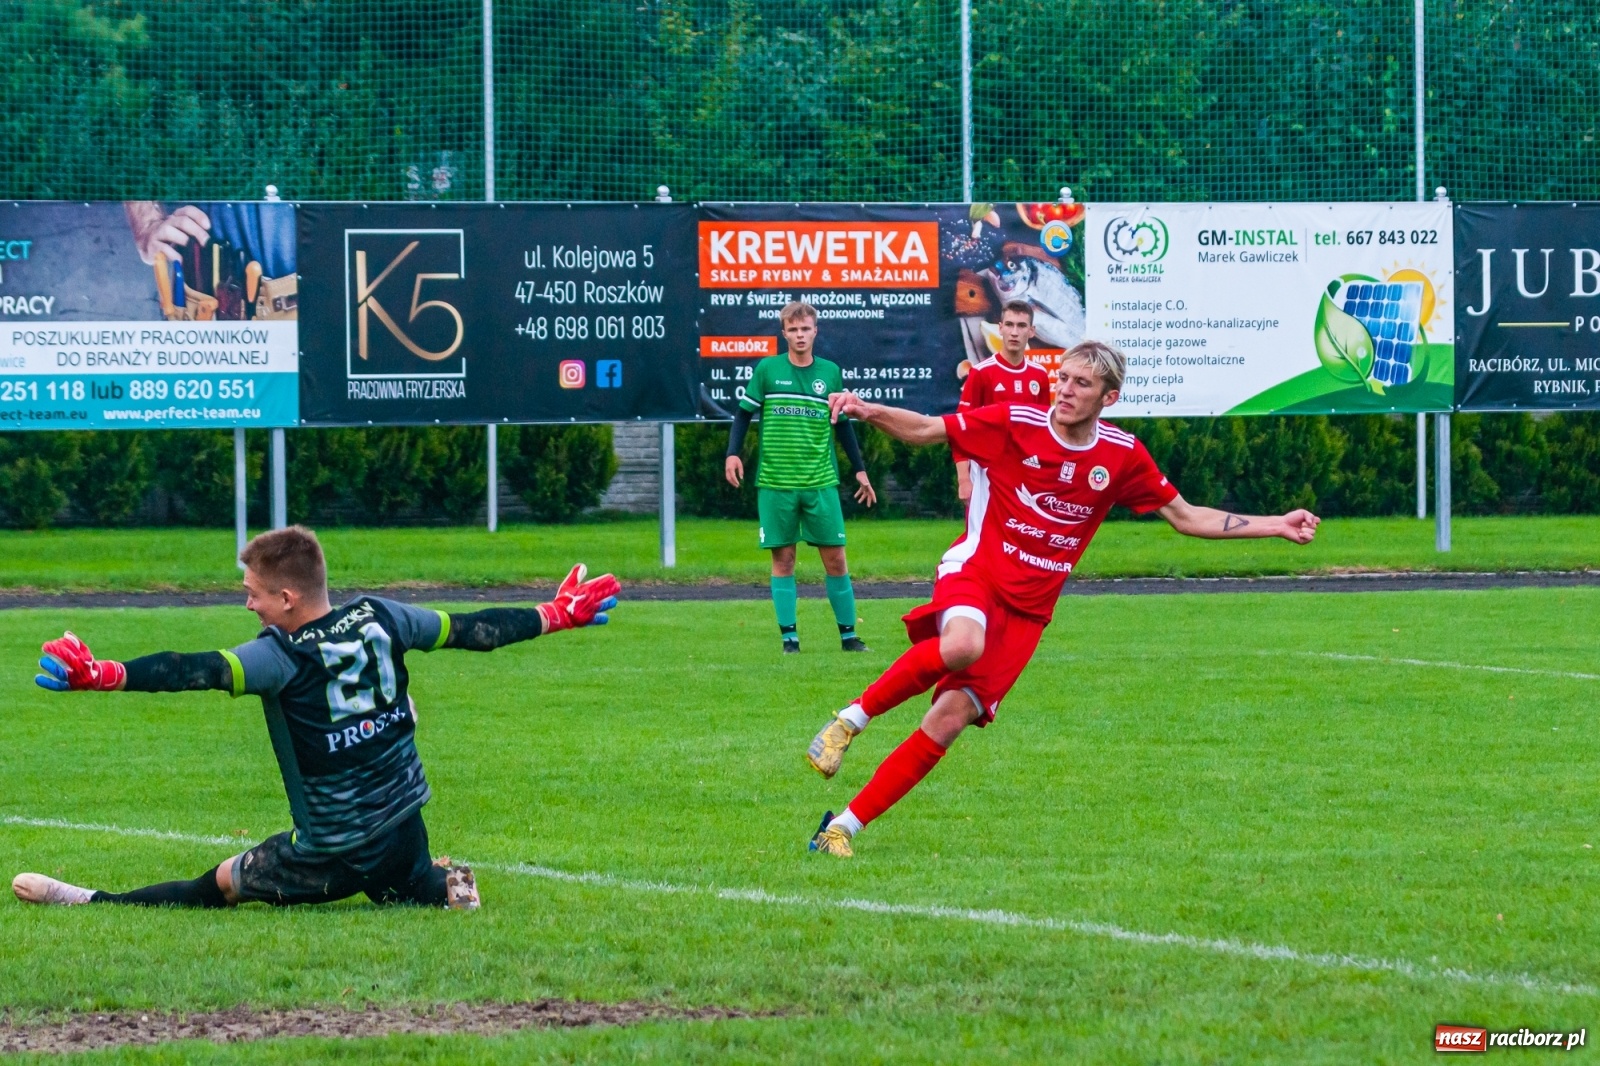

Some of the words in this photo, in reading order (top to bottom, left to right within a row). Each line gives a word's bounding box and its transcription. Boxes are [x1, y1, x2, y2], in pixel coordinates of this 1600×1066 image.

[1198, 229, 1298, 246] GM-INSTAL
[1314, 230, 1341, 245] tel.
[1346, 230, 1375, 245] 667
[1378, 230, 1406, 245] 843
[1410, 230, 1438, 244] 022
[710, 231, 929, 264] KREWETKA
[524, 245, 546, 268] ul.
[553, 245, 636, 273] Kolejowa
[643, 245, 654, 268] 5
[1198, 251, 1235, 263] Marek
[1239, 250, 1299, 263] Gawliczek
[710, 270, 757, 282] SKLEP
[763, 269, 812, 282] RYBNY
[821, 269, 832, 282] &
[841, 267, 929, 282] SMAŻALNIA
[1107, 263, 1164, 274] GM-INSTAL
[515, 281, 577, 304] 47-450
[584, 280, 664, 303] Roszków
[711, 294, 743, 305] RYBY
[801, 291, 866, 307] MROŻONE,
[870, 294, 931, 308] WĘDZONE
[0, 296, 54, 315] RACY
[1111, 300, 1162, 313] instalacje
[1166, 300, 1187, 311] C.O.
[816, 310, 884, 319] ŁODKOWODNE
[514, 317, 548, 340] +48
[554, 316, 588, 340] 698
[595, 316, 625, 339] 061
[632, 315, 665, 339] 803
[1111, 318, 1162, 331] instalacje
[1165, 317, 1279, 331] wodno-kanalizacyjne
[12, 331, 136, 346] POSZUKUJEMY
[141, 327, 269, 345] PRACOWNIKÓW
[1165, 338, 1207, 350] gazowe
[711, 338, 768, 353] RACIBÓRZ
[56, 352, 81, 367] DO
[86, 349, 152, 366] BRANŻY
[157, 350, 269, 366] BUDOWALNEJ
[1127, 356, 1162, 368] talacje
[1165, 355, 1245, 366] fotowoltaiczne
[1469, 355, 1544, 373] RACIBÓRZ,
[1548, 358, 1571, 372] UL.
[711, 368, 731, 380] UL.
[842, 367, 861, 379] tel.
[863, 368, 877, 379] 32
[879, 368, 900, 379] 415
[902, 368, 916, 379] 22
[918, 368, 932, 379] 32
[1125, 376, 1149, 387] mpy
[1152, 373, 1184, 387] ciepła
[1, 381, 38, 401] 251
[46, 381, 85, 401] 118
[91, 380, 124, 399] lub
[129, 379, 168, 400] 889
[173, 379, 213, 399] 620
[218, 379, 255, 399] 551
[347, 380, 404, 399] PRACOWNIA
[405, 380, 466, 399] FRYZJERSKA
[711, 388, 731, 400] UL.
[852, 388, 872, 399] 666
[874, 388, 882, 399] 0
[884, 388, 904, 399] 111
[1534, 379, 1590, 395] RYBNIK,
[1117, 392, 1176, 405] ekuperacja
[103, 406, 261, 422] www.perfect-team.eu
[1005, 518, 1046, 538] SACHS
[318, 622, 397, 723] 21
